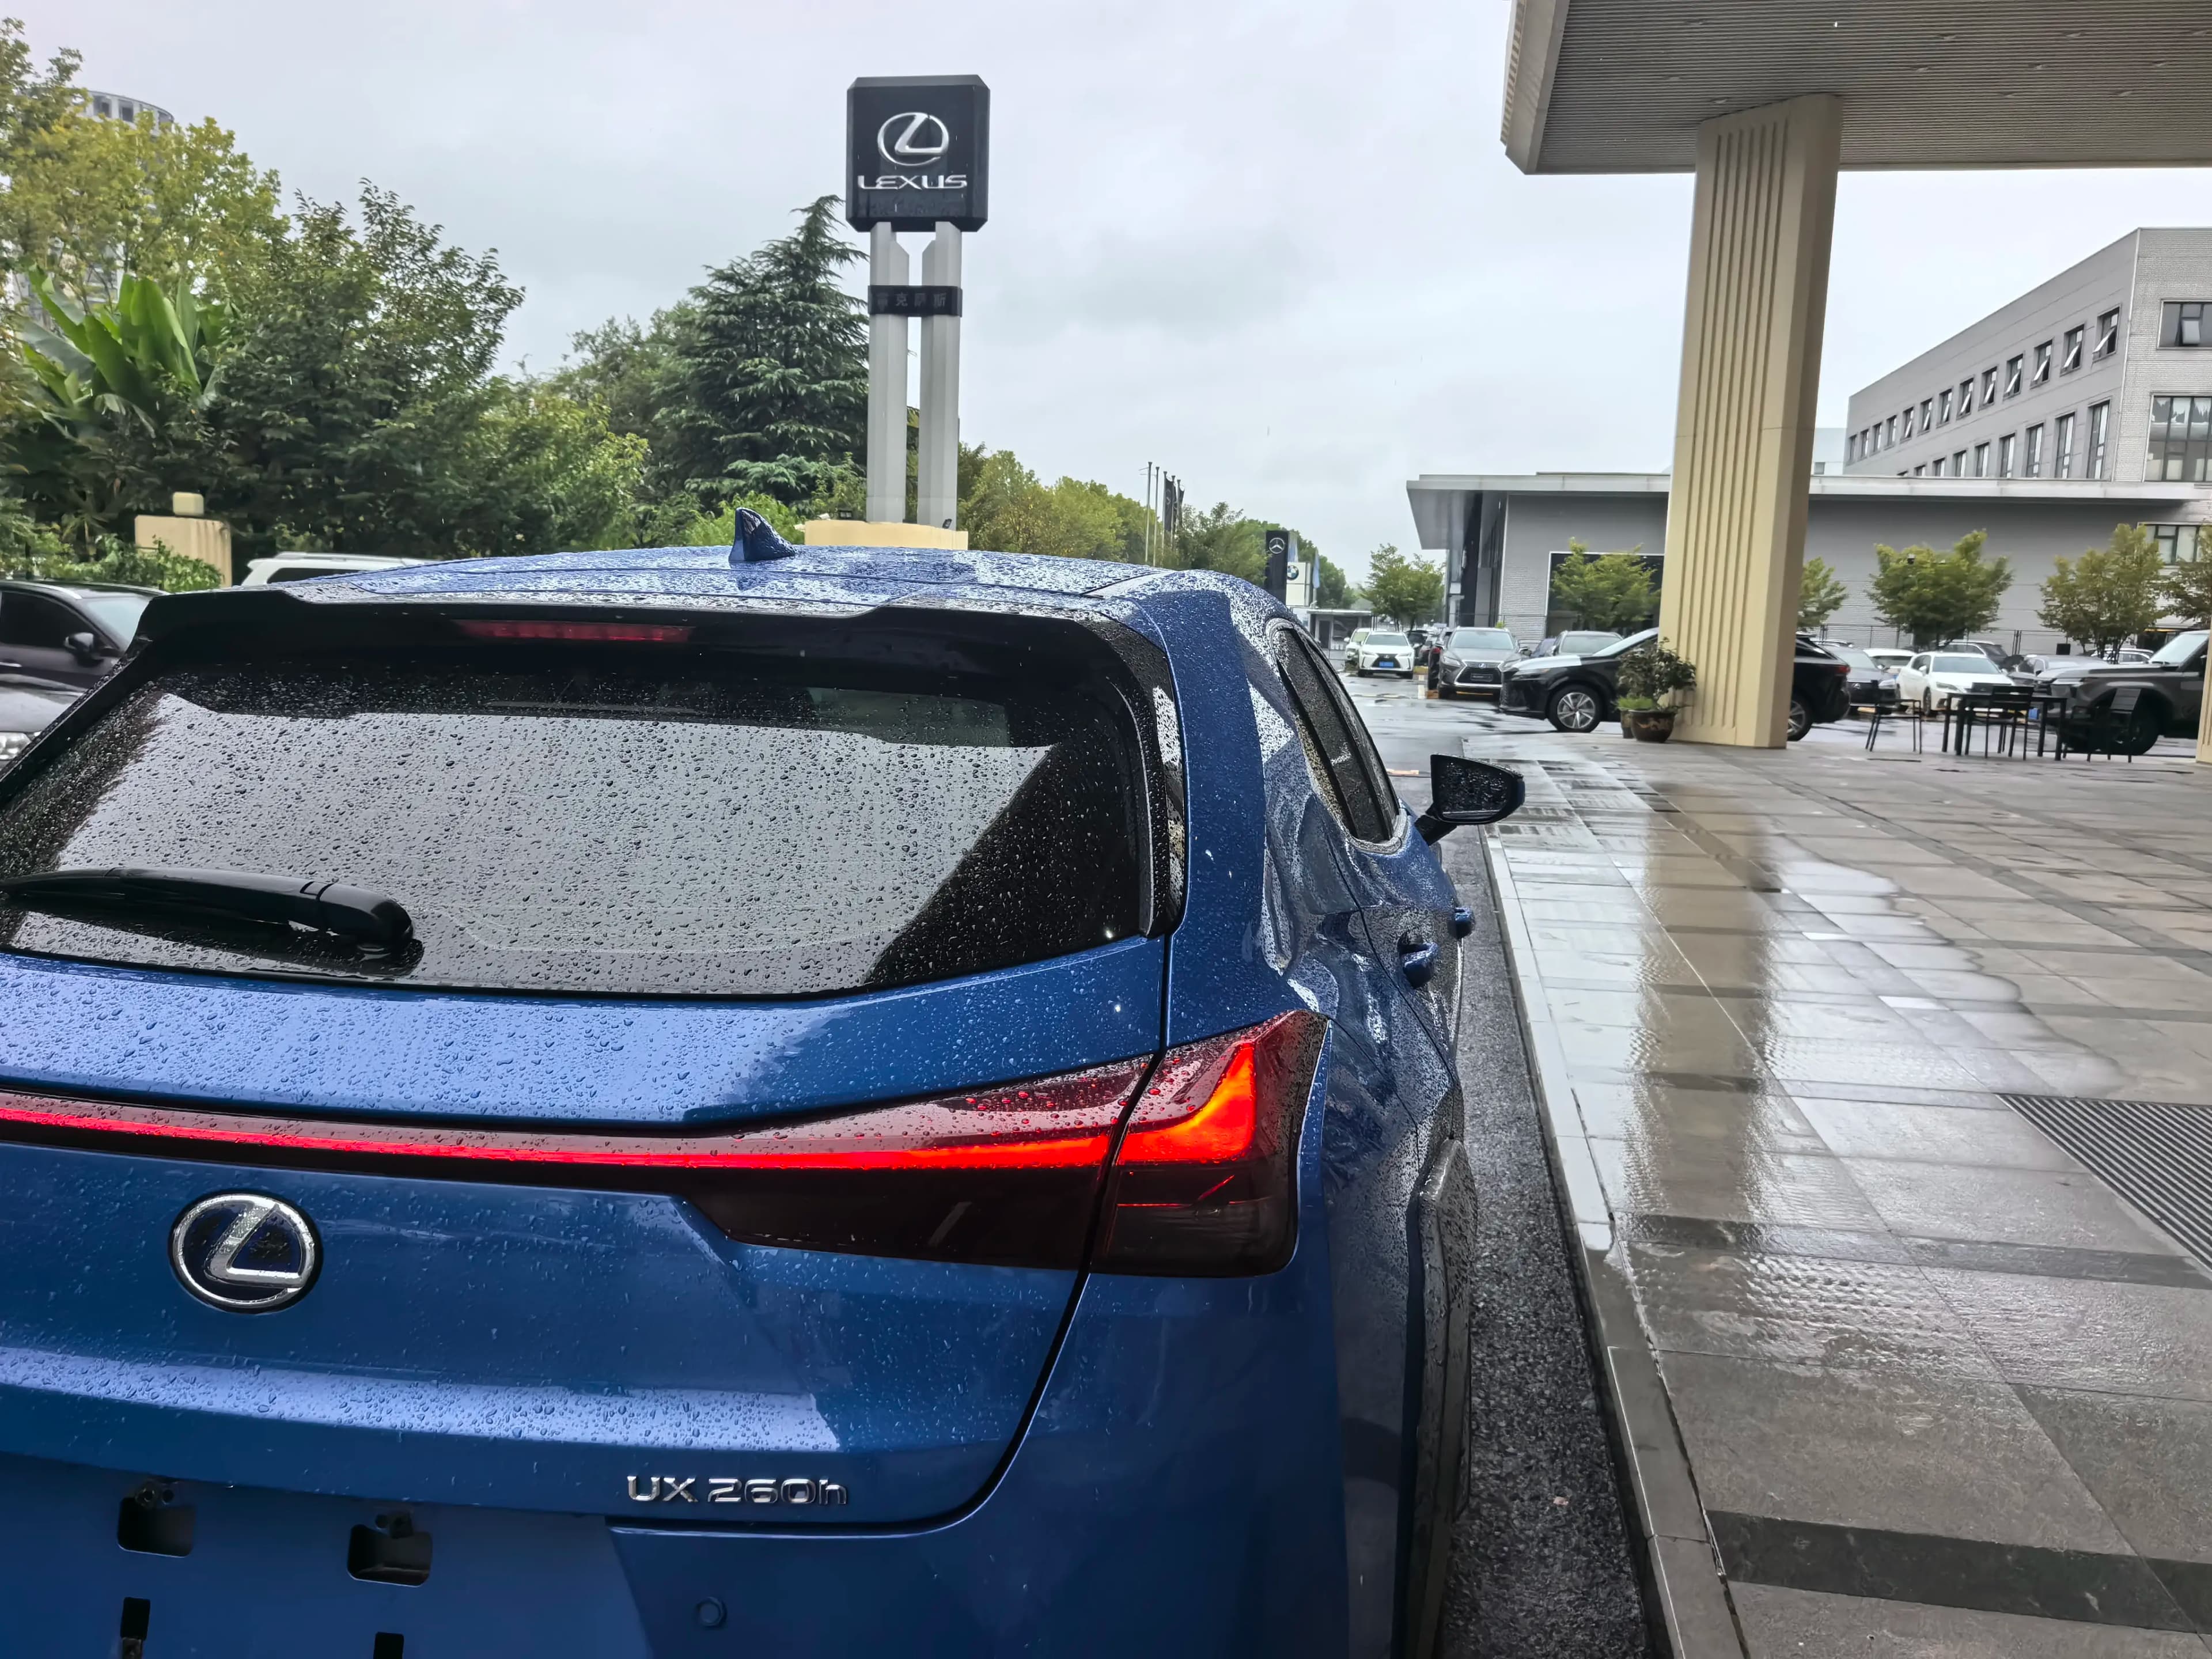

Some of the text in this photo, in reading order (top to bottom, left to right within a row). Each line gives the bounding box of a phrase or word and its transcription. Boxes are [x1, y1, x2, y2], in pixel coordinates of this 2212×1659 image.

[858, 175, 968, 190] LEXUS
[627, 1476, 847, 1505] UX 260h
